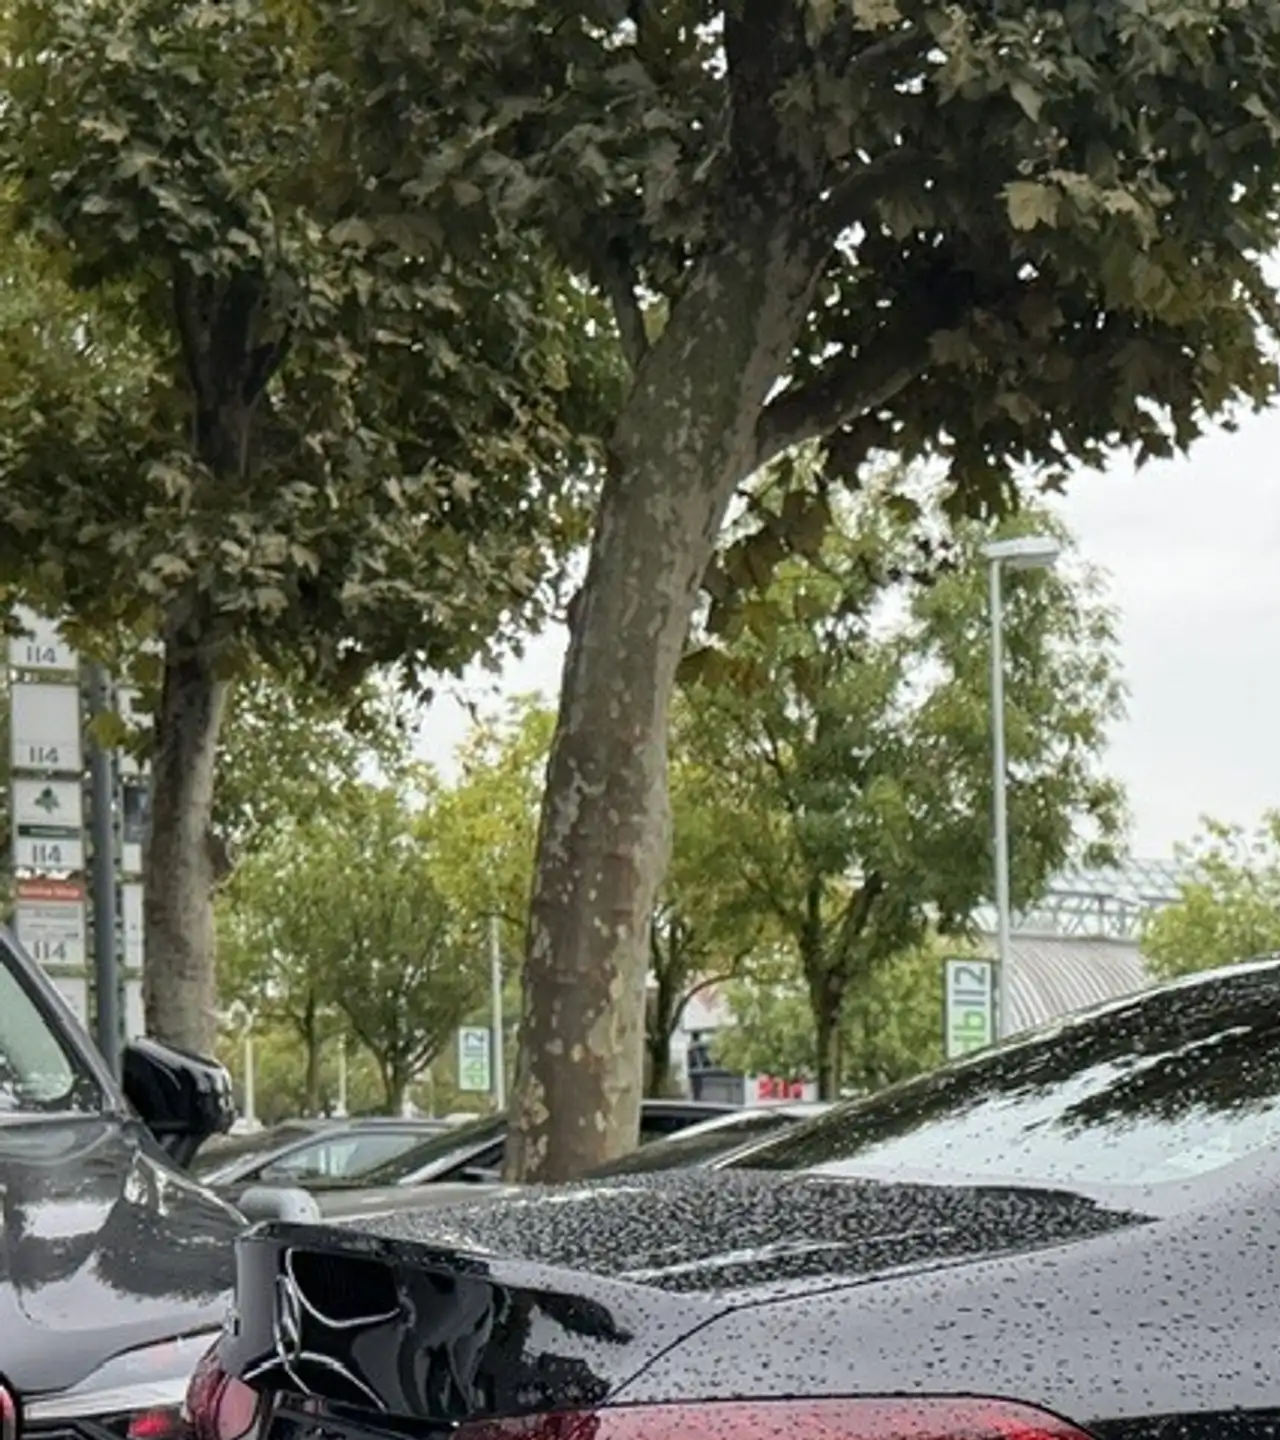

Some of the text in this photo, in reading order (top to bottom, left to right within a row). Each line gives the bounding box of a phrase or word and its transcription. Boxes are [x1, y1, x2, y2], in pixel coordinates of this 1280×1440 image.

[27, 645, 57, 664] 114
[29, 746, 59, 764] 114
[32, 843, 63, 863] 114
[33, 939, 67, 961] 114
